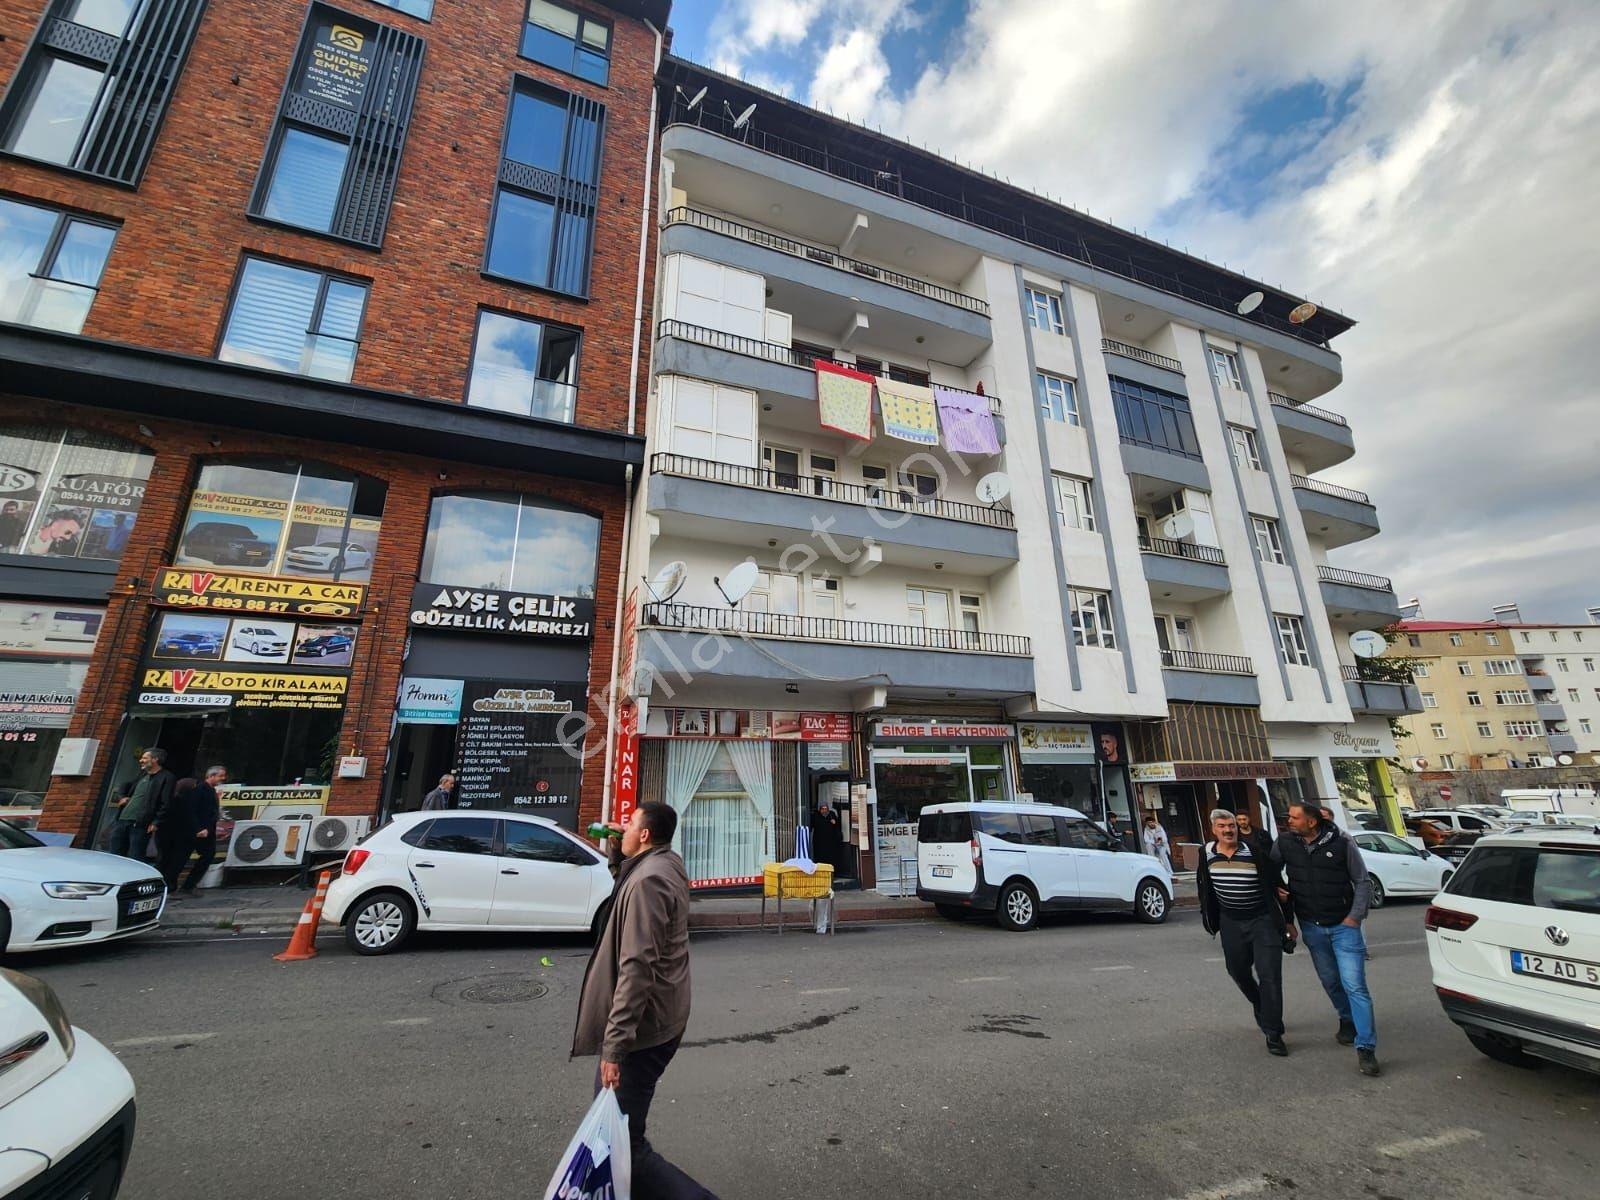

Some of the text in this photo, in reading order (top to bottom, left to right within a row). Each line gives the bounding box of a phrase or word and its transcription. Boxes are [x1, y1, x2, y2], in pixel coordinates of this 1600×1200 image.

[313, 49, 368, 73] GUIDER
[315, 58, 361, 79] EMLAK
[56, 478, 147, 498] KUAFÖR
[229, 496, 255, 507] RENT
[266, 500, 288, 511] CAR
[326, 508, 342, 517] OTO
[162, 571, 358, 600] RAVZA RENT A CAR
[167, 593, 289, 612] 0545 893 88 27
[431, 588, 577, 619] AYŞE ÇELİK
[410, 609, 590, 637] GÜZELLİK MERKEZİ
[142, 668, 344, 694] RAVZA OTO KİRALAMA
[14, 691, 74, 703] MAKİNA
[142, 695, 171, 703] 0545
[22, 732, 37, 742] 12
[882, 725, 925, 737] SİMGE
[241, 792, 264, 800] OTO
[266, 790, 318, 800] KİRALAMA
[514, 796, 532, 804] 0542
[534, 796, 547, 804] 121
[559, 795, 568, 803] 12
[1524, 956, 1544, 973] 12
[1554, 961, 1577, 978] AD
